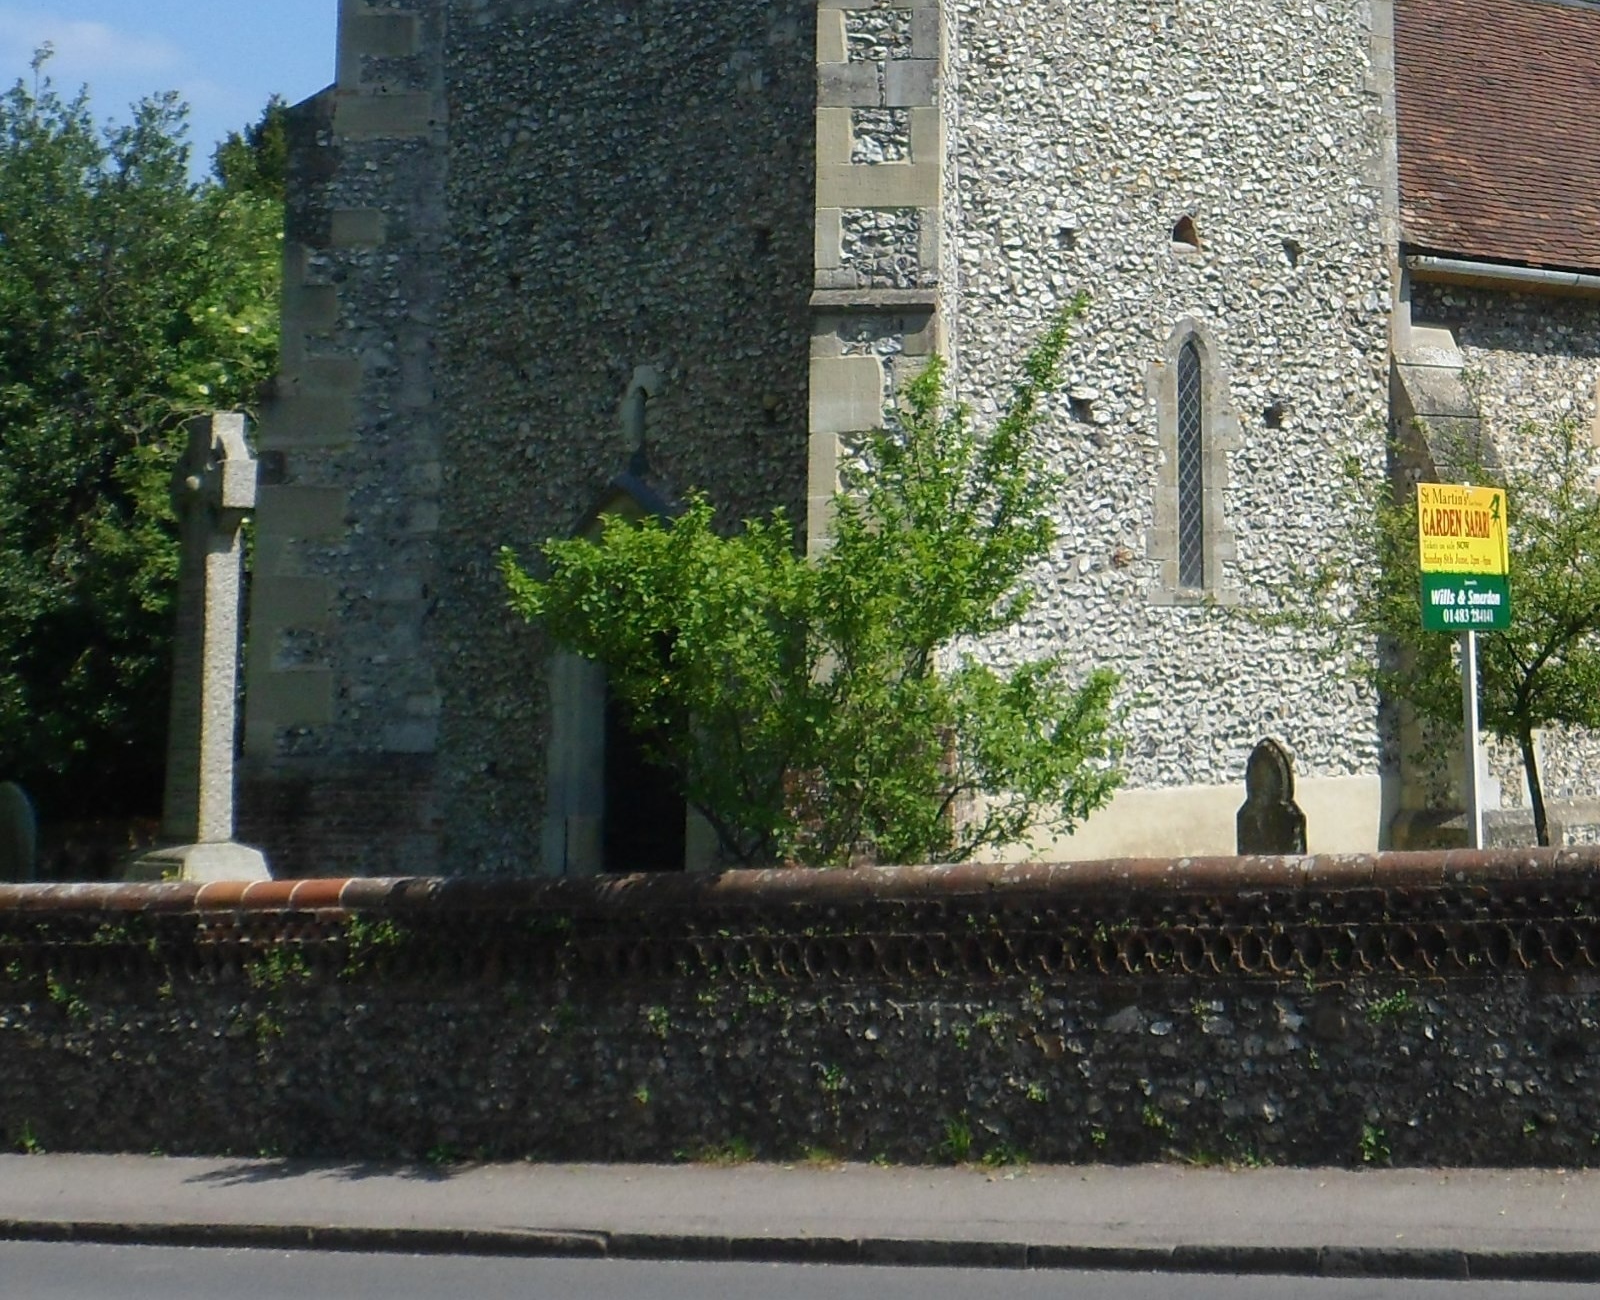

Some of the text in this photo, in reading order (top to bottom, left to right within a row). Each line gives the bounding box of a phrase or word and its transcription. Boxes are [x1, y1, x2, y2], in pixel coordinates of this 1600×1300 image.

[1421, 487, 1430, 504] St
[1422, 507, 1490, 538] GARDEN SAFARI
[1456, 541, 1470, 550] NOW
[1423, 552, 1442, 567] Sunday
[1443, 553, 1454, 565] 8th
[1431, 588, 1501, 606] Wills & Smerdon
[1443, 608, 1494, 624] 01483 284141
